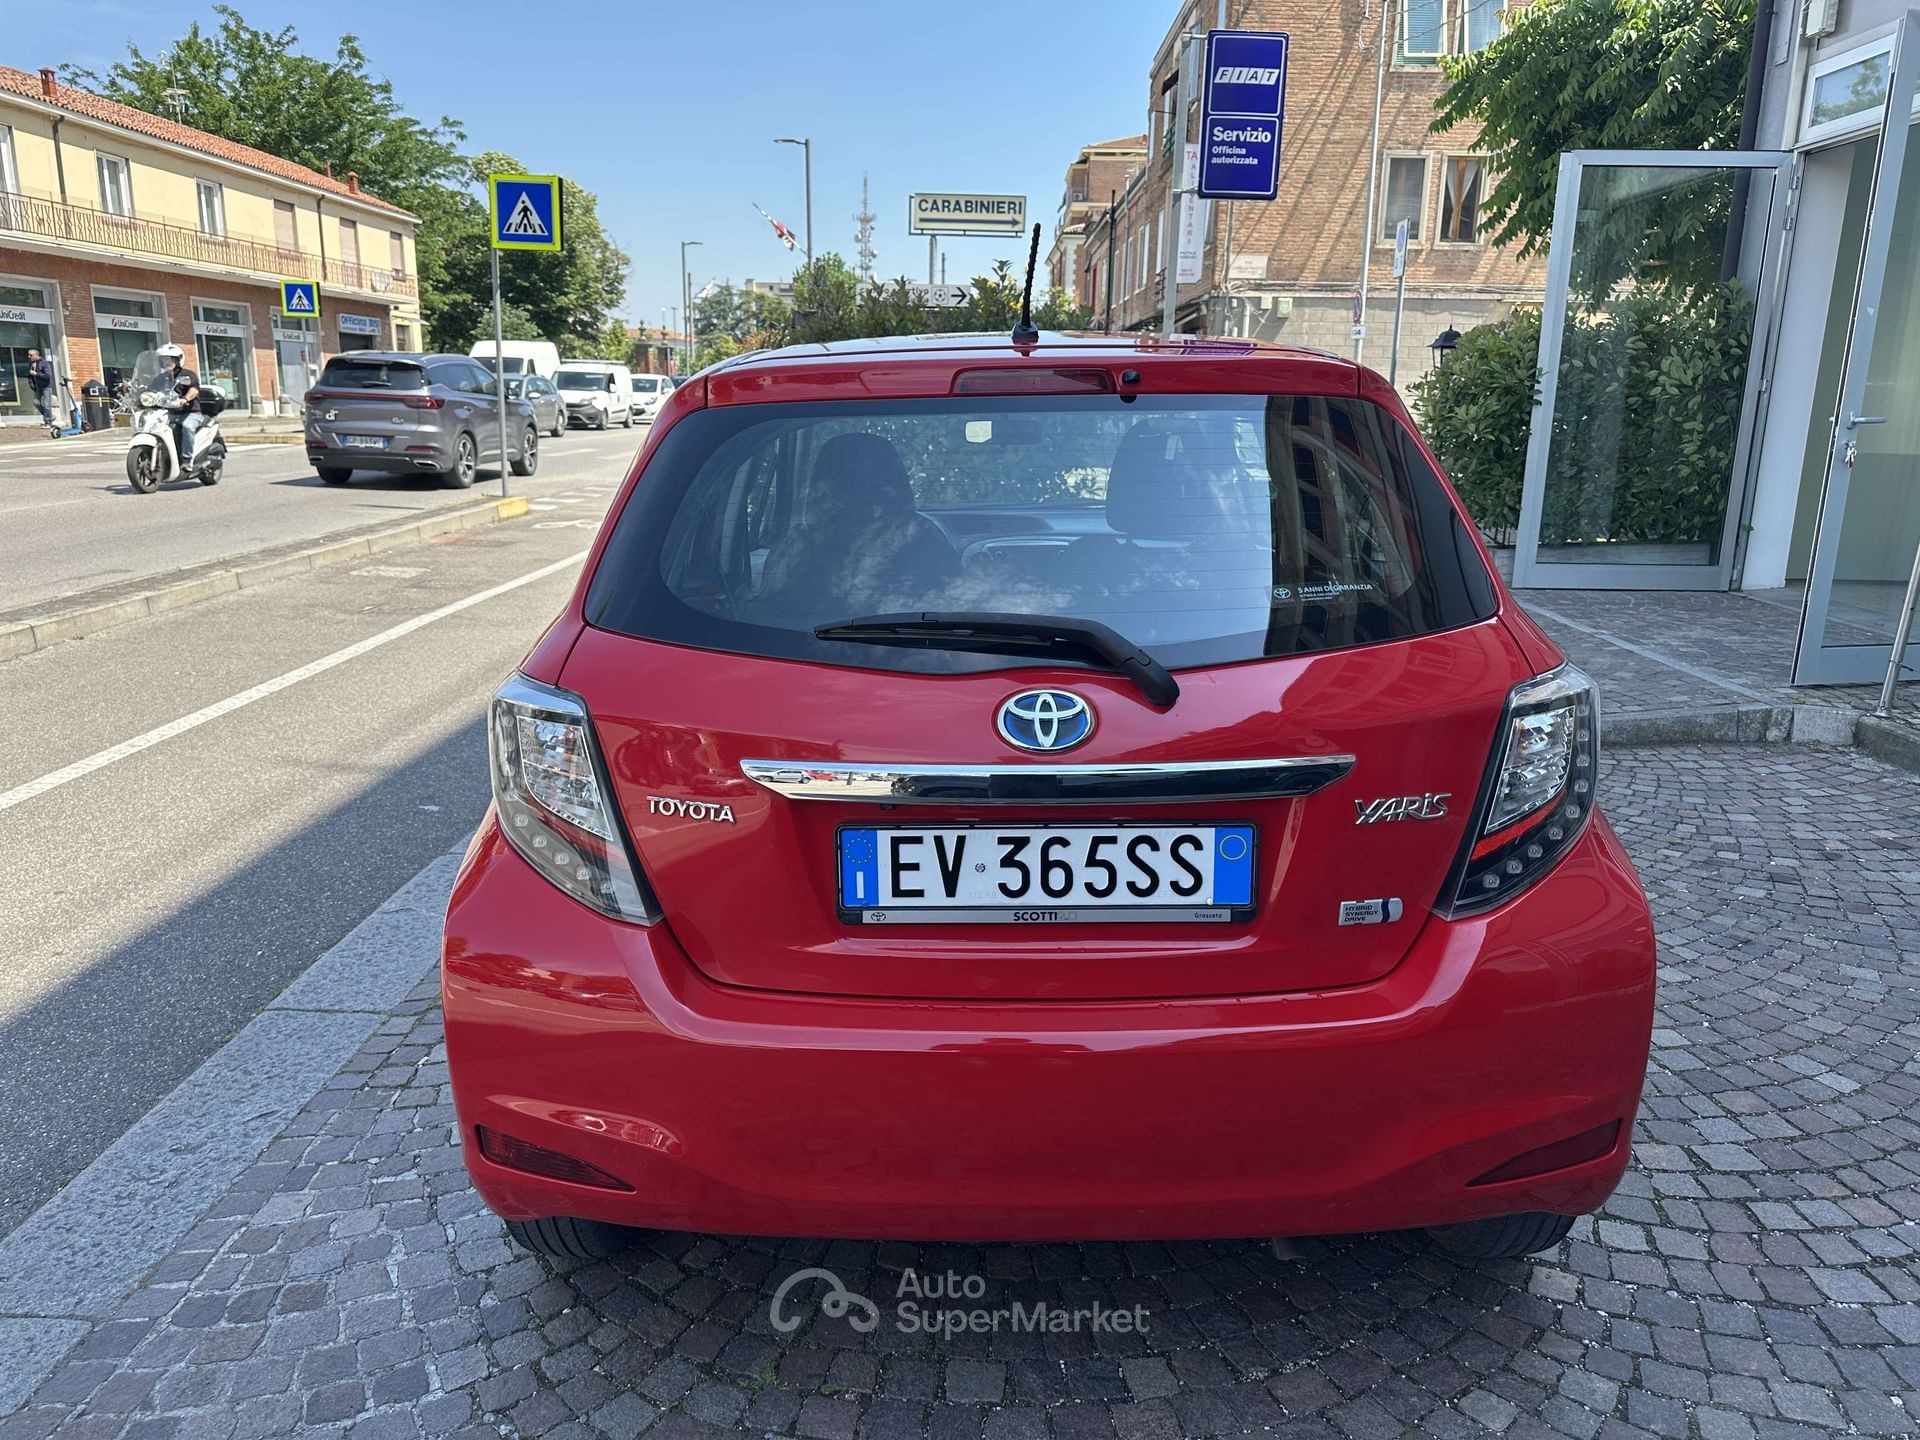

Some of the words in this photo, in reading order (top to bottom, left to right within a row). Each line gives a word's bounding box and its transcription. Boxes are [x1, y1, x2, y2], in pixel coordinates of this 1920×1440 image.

[1217, 68, 1278, 83] FIAT
[1213, 127, 1271, 143] Servizio
[1212, 146, 1246, 155] Officina
[1211, 156, 1258, 165] autorizzata
[918, 199, 1022, 214] CARABINIERI
[117, 319, 139, 329] UniCredit
[1304, 585, 1323, 593] ANNI
[1333, 583, 1373, 592] GARANZIA
[646, 796, 736, 824] TOYOTA
[890, 834, 967, 898] EV
[997, 834, 1204, 898] 365SS
[1345, 904, 1373, 912] HYBRID
